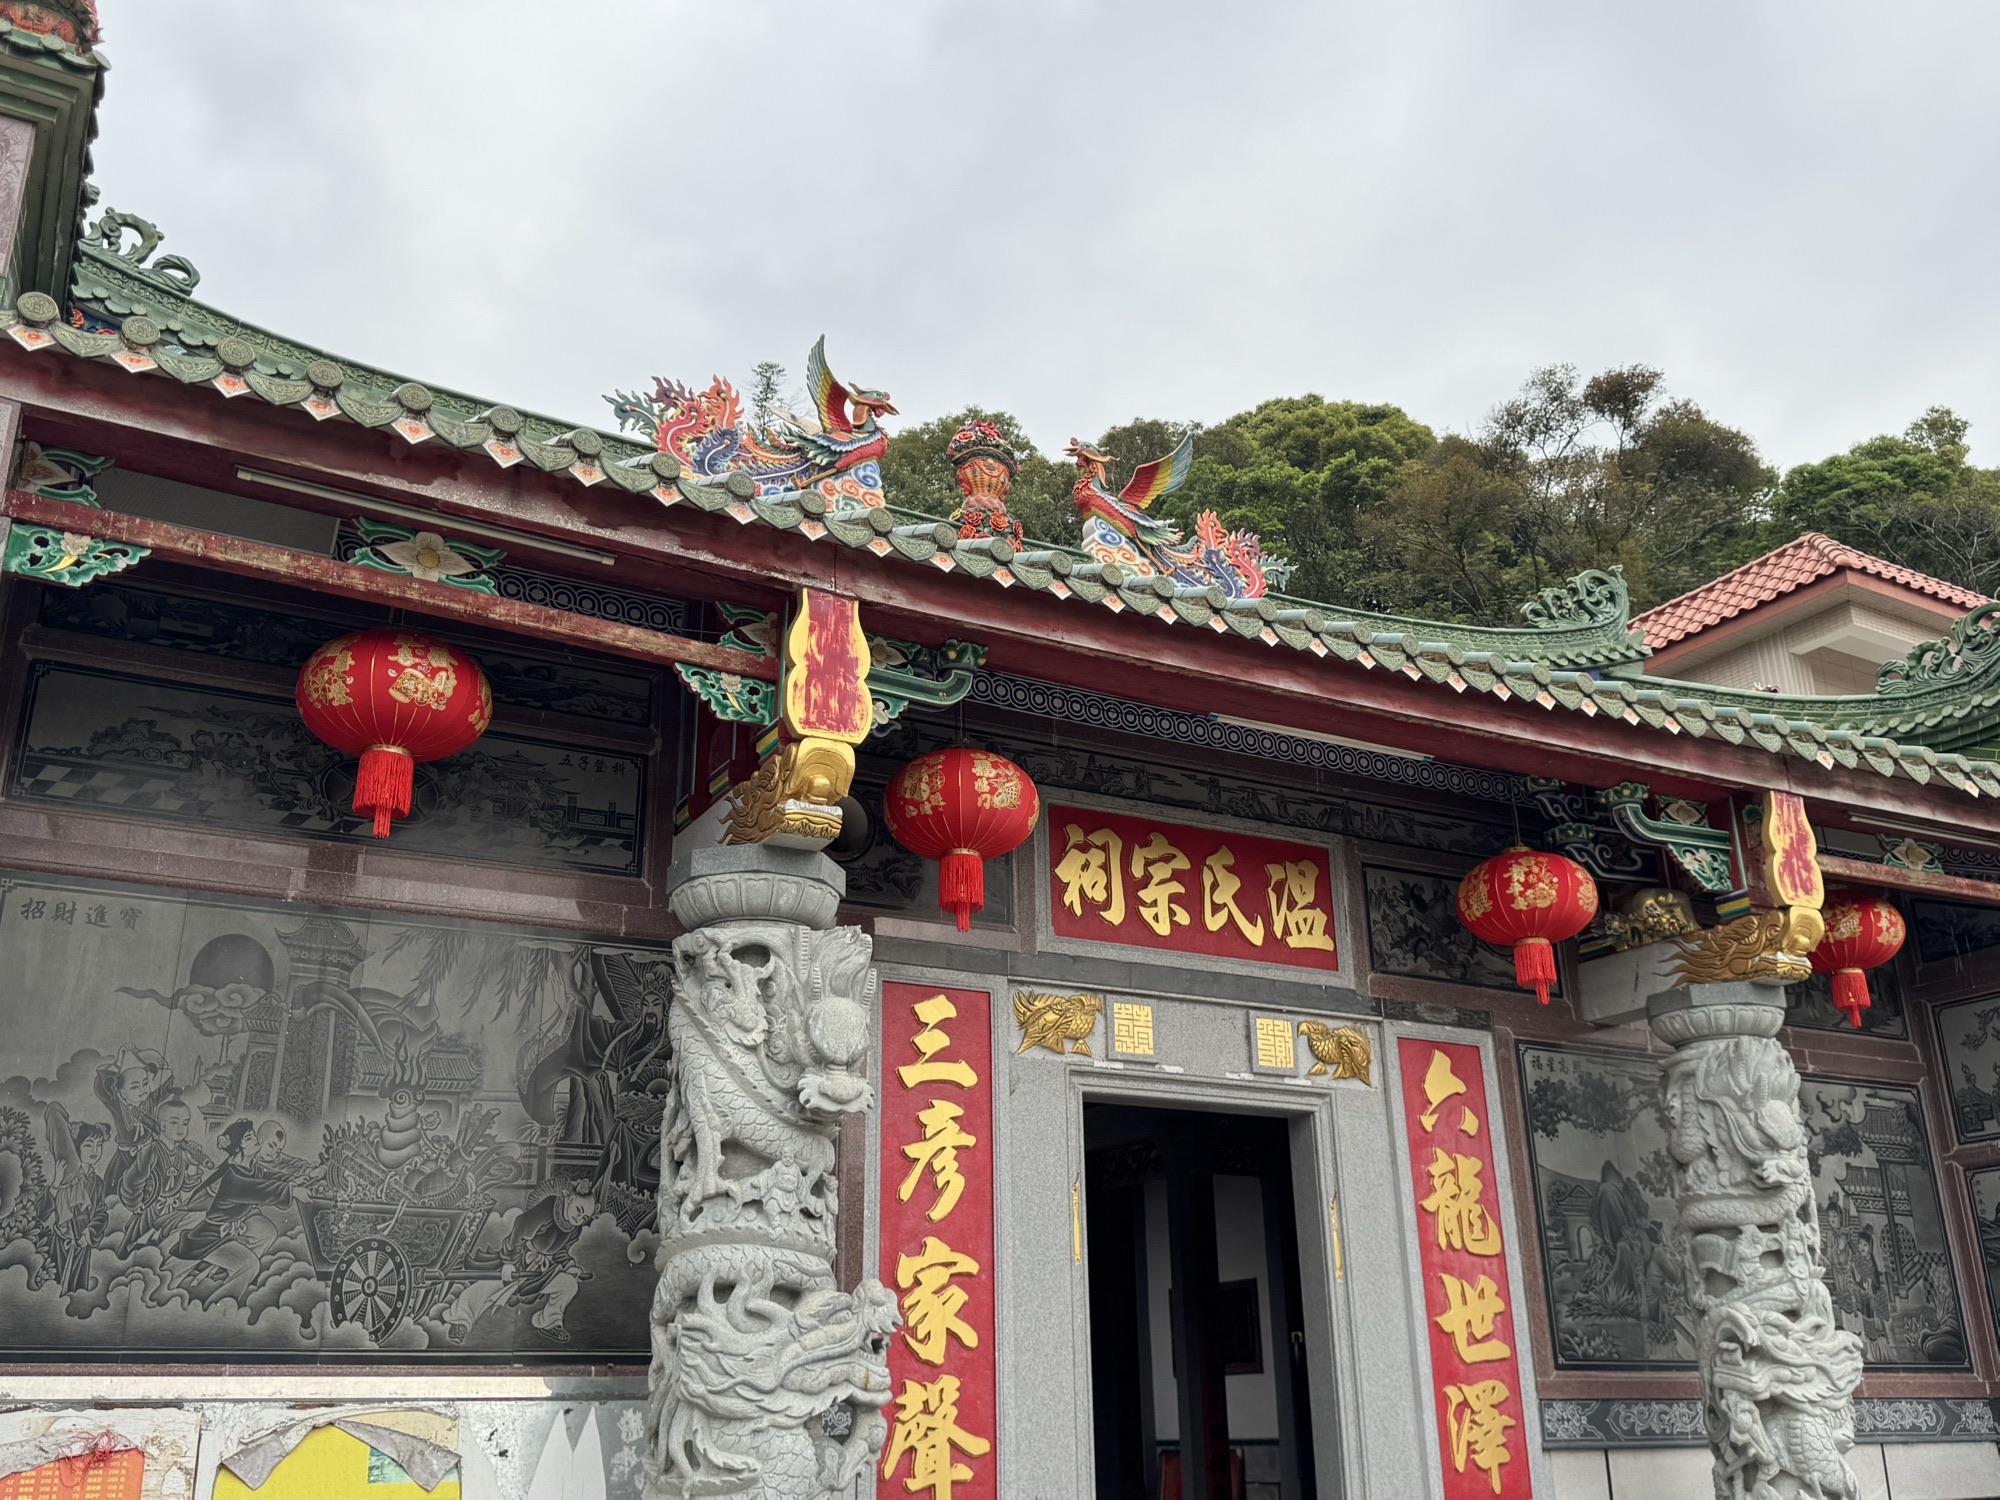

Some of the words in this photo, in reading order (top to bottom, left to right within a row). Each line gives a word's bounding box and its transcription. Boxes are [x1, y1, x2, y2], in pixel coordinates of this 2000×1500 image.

[558, 754, 626, 778] 五子登科
[21, 897, 142, 930] 招財進寶
[1419, 1049, 1516, 1495] 六龍世澤
